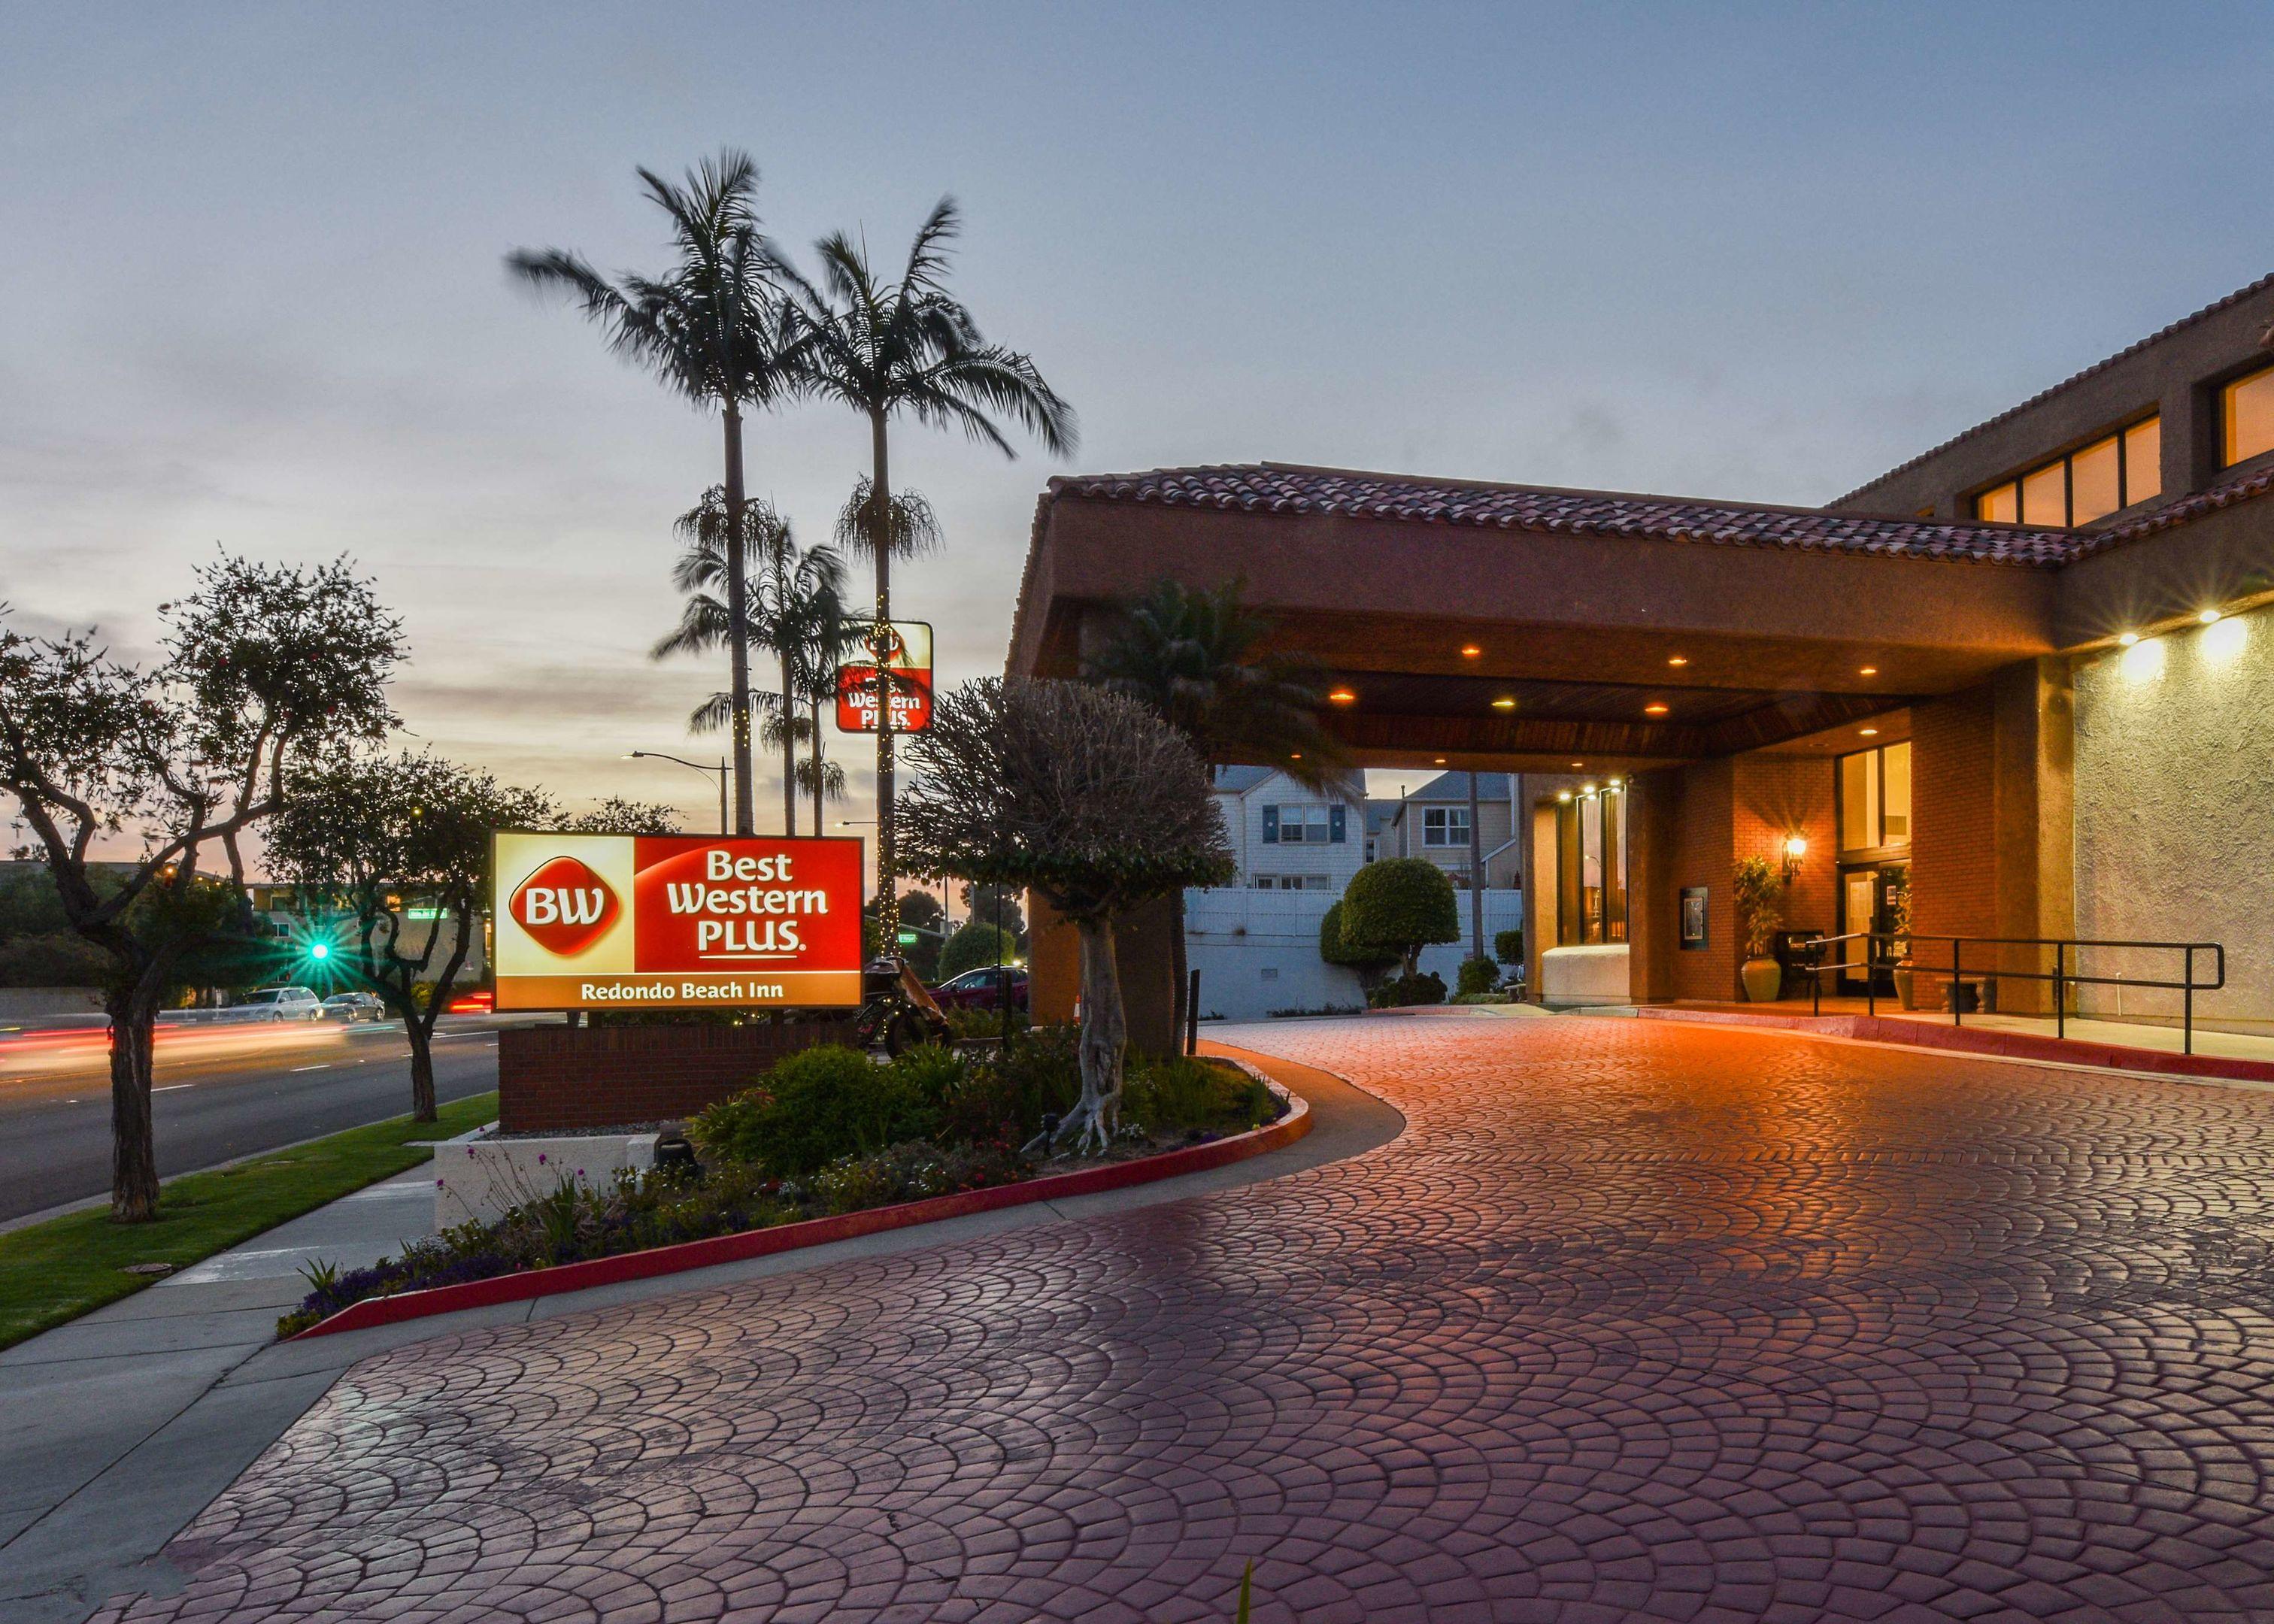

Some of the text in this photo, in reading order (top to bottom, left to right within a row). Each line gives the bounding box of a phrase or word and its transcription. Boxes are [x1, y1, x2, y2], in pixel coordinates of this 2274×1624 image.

[848, 692, 920, 709] Weern
[707, 850, 793, 882] Best
[526, 888, 605, 925] BW
[666, 883, 829, 914] Western
[581, 981, 784, 1000] Redondo Beach Inn
